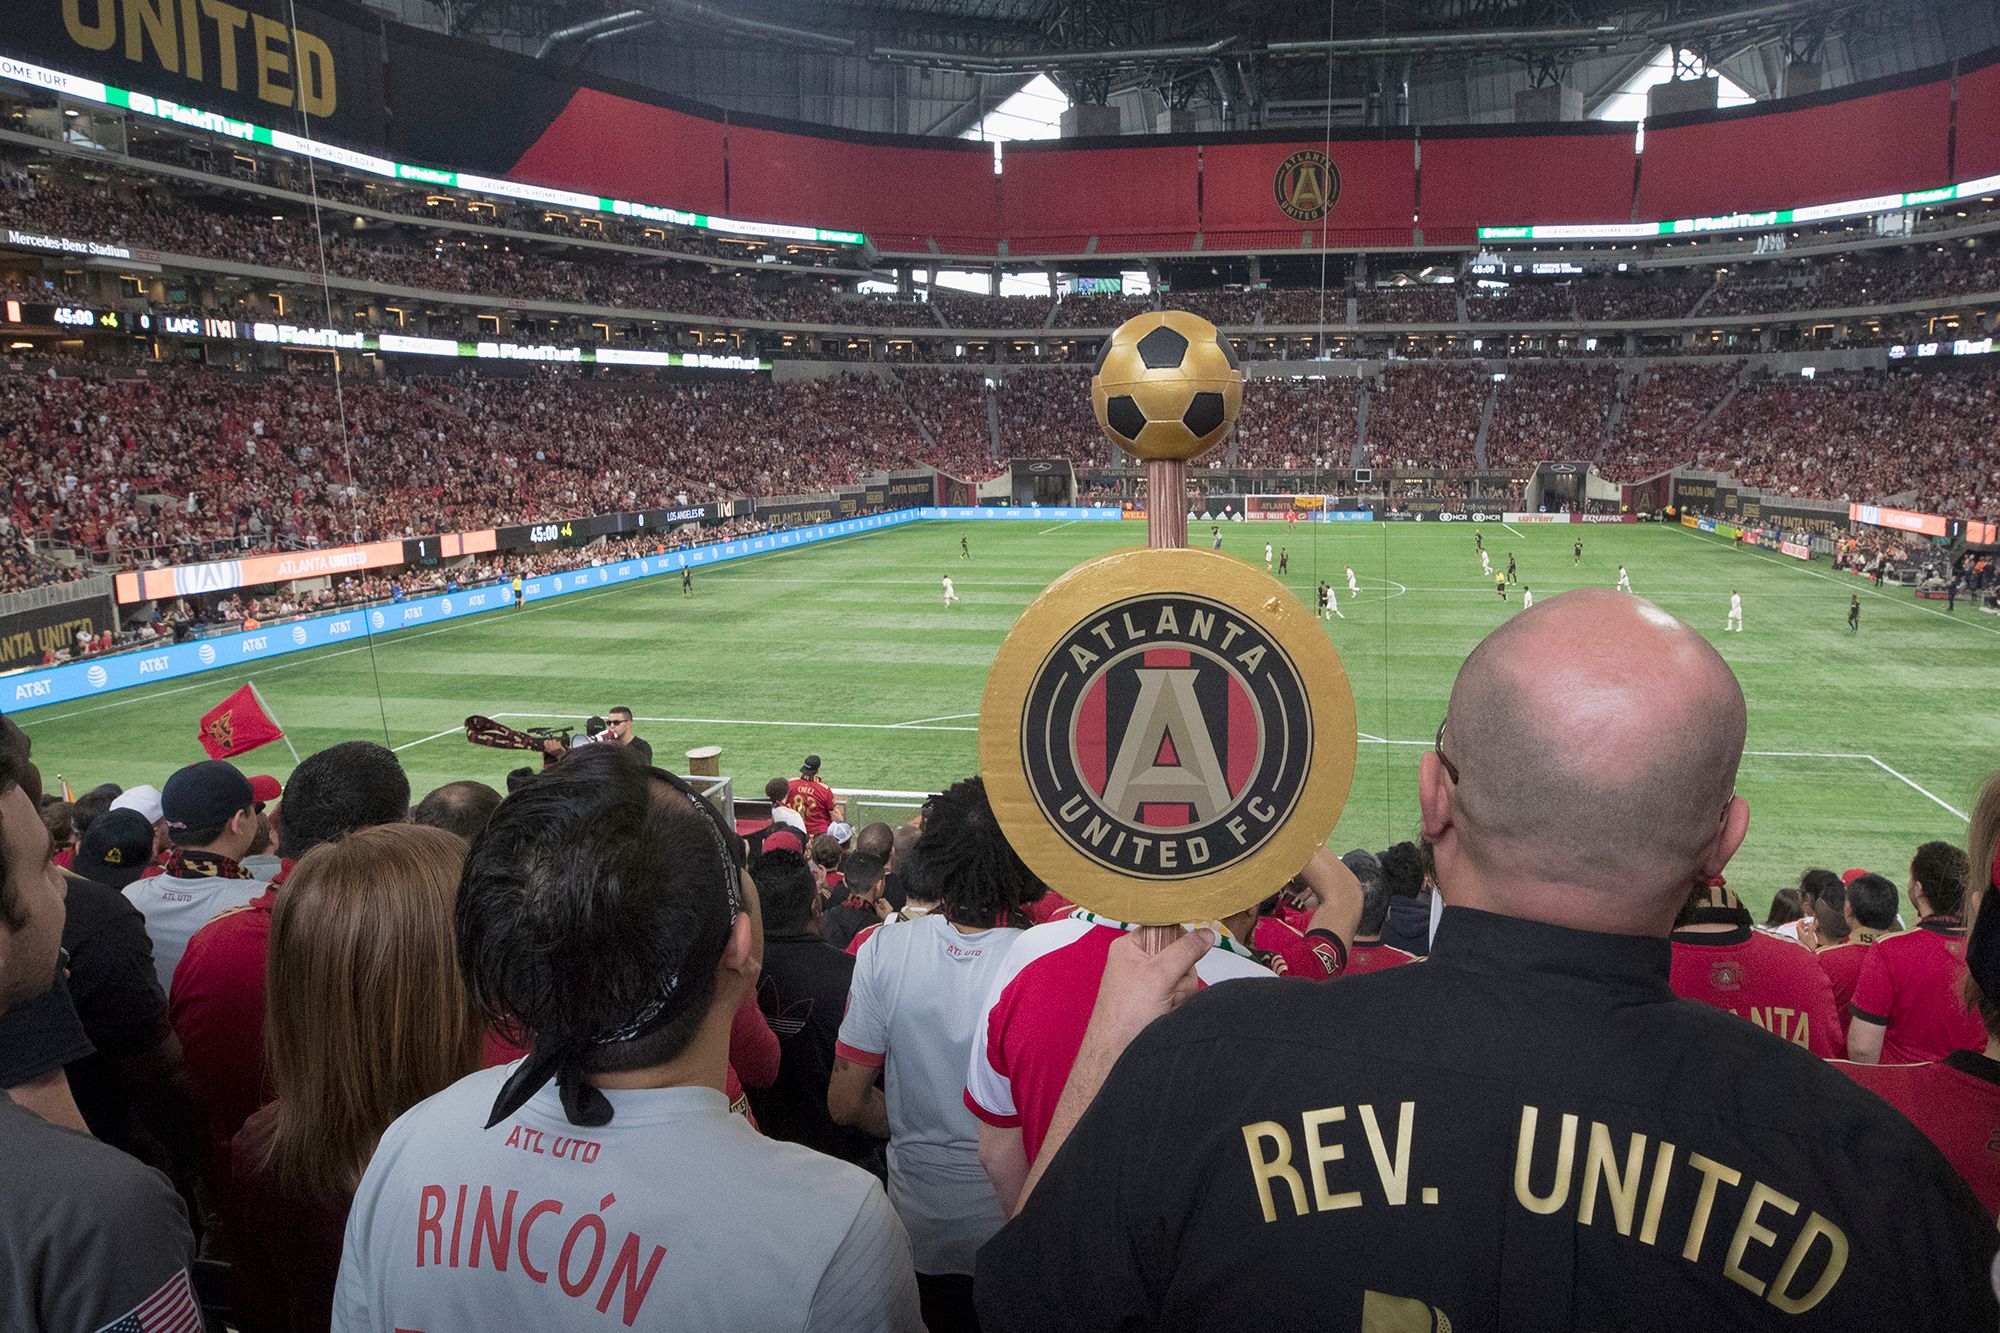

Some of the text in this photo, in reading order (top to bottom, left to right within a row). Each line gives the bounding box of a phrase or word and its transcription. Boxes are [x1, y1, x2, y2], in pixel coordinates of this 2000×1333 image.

[61, 0, 338, 118] UNITED
[37, 71, 68, 88] TURF
[158, 99, 255, 141] FieldTurf
[632, 203, 696, 227] FieldTurf
[1281, 201, 1318, 220] UNITED
[1695, 212, 1777, 232] FieldTurf
[8, 230, 88, 253] Mercedes-Benz
[88, 241, 131, 259] Stadium
[53, 307, 200, 334] 45:00 +4 0 LAFC
[279, 324, 364, 349] FieldTurf
[500, 344, 581, 362] FieldTurf
[667, 512, 677, 522] LOS
[677, 509, 698, 520] ANGELES
[768, 509, 832, 525] ATLANTA UNITED
[1582, 513, 1624, 523] EQUIFAX
[530, 522, 573, 543] 45:00 +4
[418, 541, 425, 557] 1
[278, 551, 368, 577] ATLANTA UNITED
[618, 566, 630, 576] AT&T
[525, 583, 541, 595] AT&T
[574, 574, 588, 585] AT&T
[468, 594, 486, 607] AT&T
[403, 606, 423, 620] AT&T
[329, 620, 351, 635] AT&T
[242, 636, 267, 653] AT&T
[1067, 605, 1269, 675] ATLANTA
[139, 656, 169, 674] AT&T
[15, 679, 52, 700] AT&T
[1059, 793, 1277, 868] UNITED FC
[162, 892, 193, 902] ATL UTD
[505, 1124, 602, 1165] ATL UTD
[1242, 1101, 1851, 1315] REV. UNITED
[416, 1184, 668, 1327] RINCÓN
